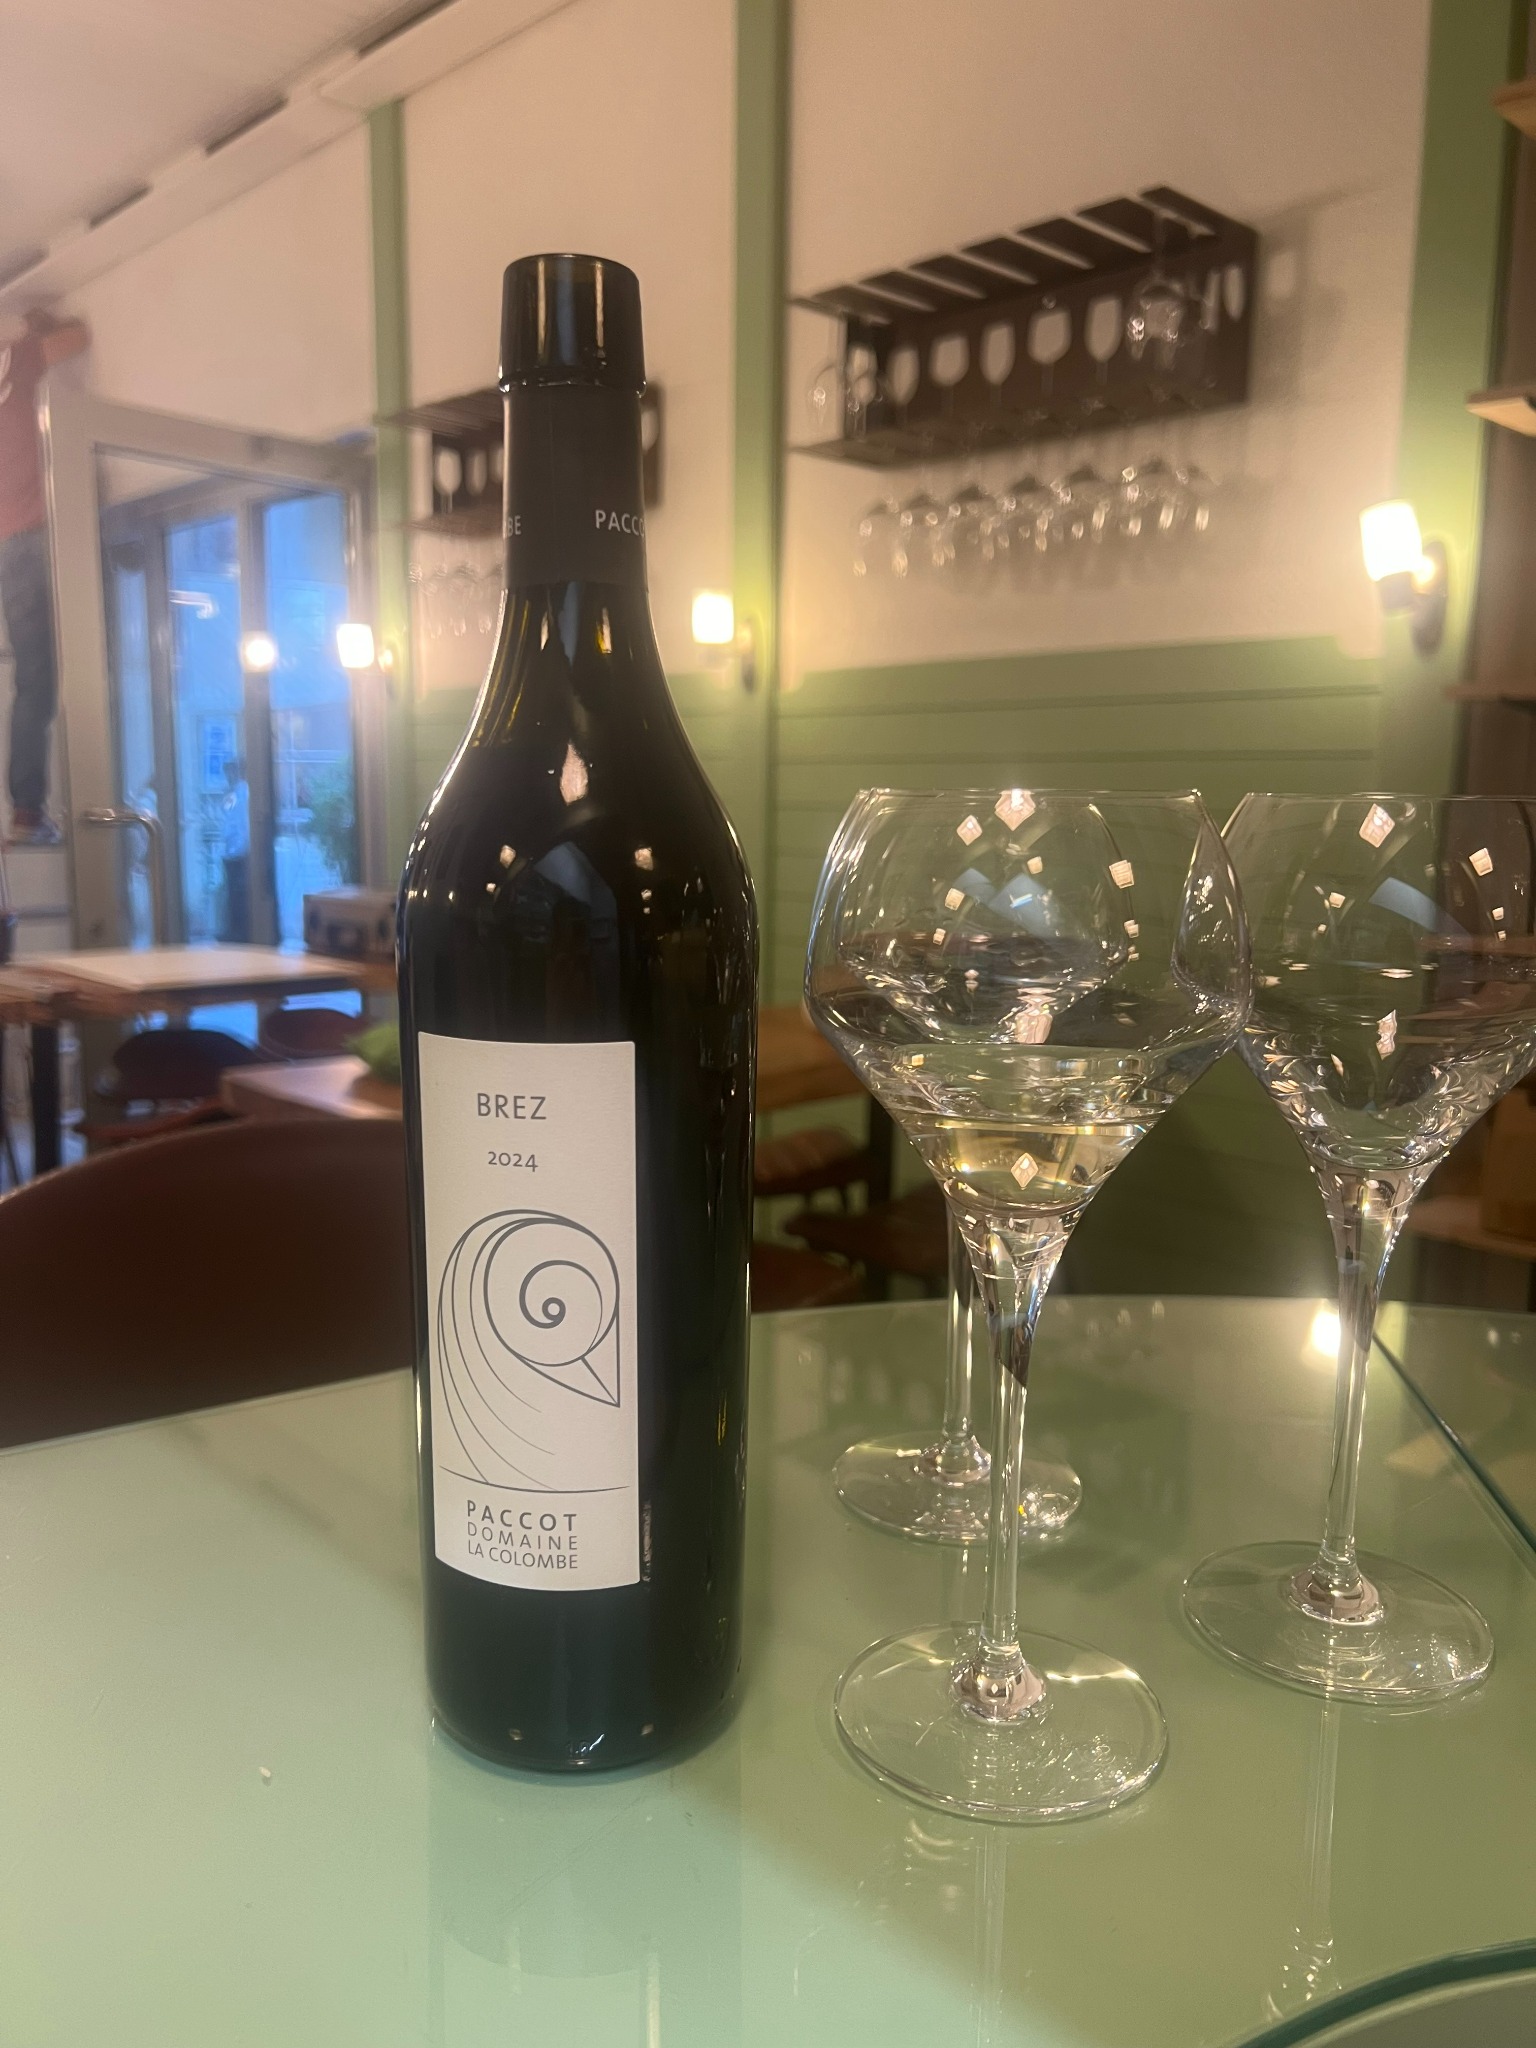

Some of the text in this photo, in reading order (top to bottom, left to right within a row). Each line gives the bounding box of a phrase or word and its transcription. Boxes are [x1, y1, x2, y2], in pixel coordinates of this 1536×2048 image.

[476, 1092, 547, 1121] BREZ
[487, 1150, 539, 1173] 2024
[466, 1499, 577, 1532] PACCOT
[467, 1521, 578, 1551] DOMAINE
[468, 1540, 579, 1569] LA COLOMBE
